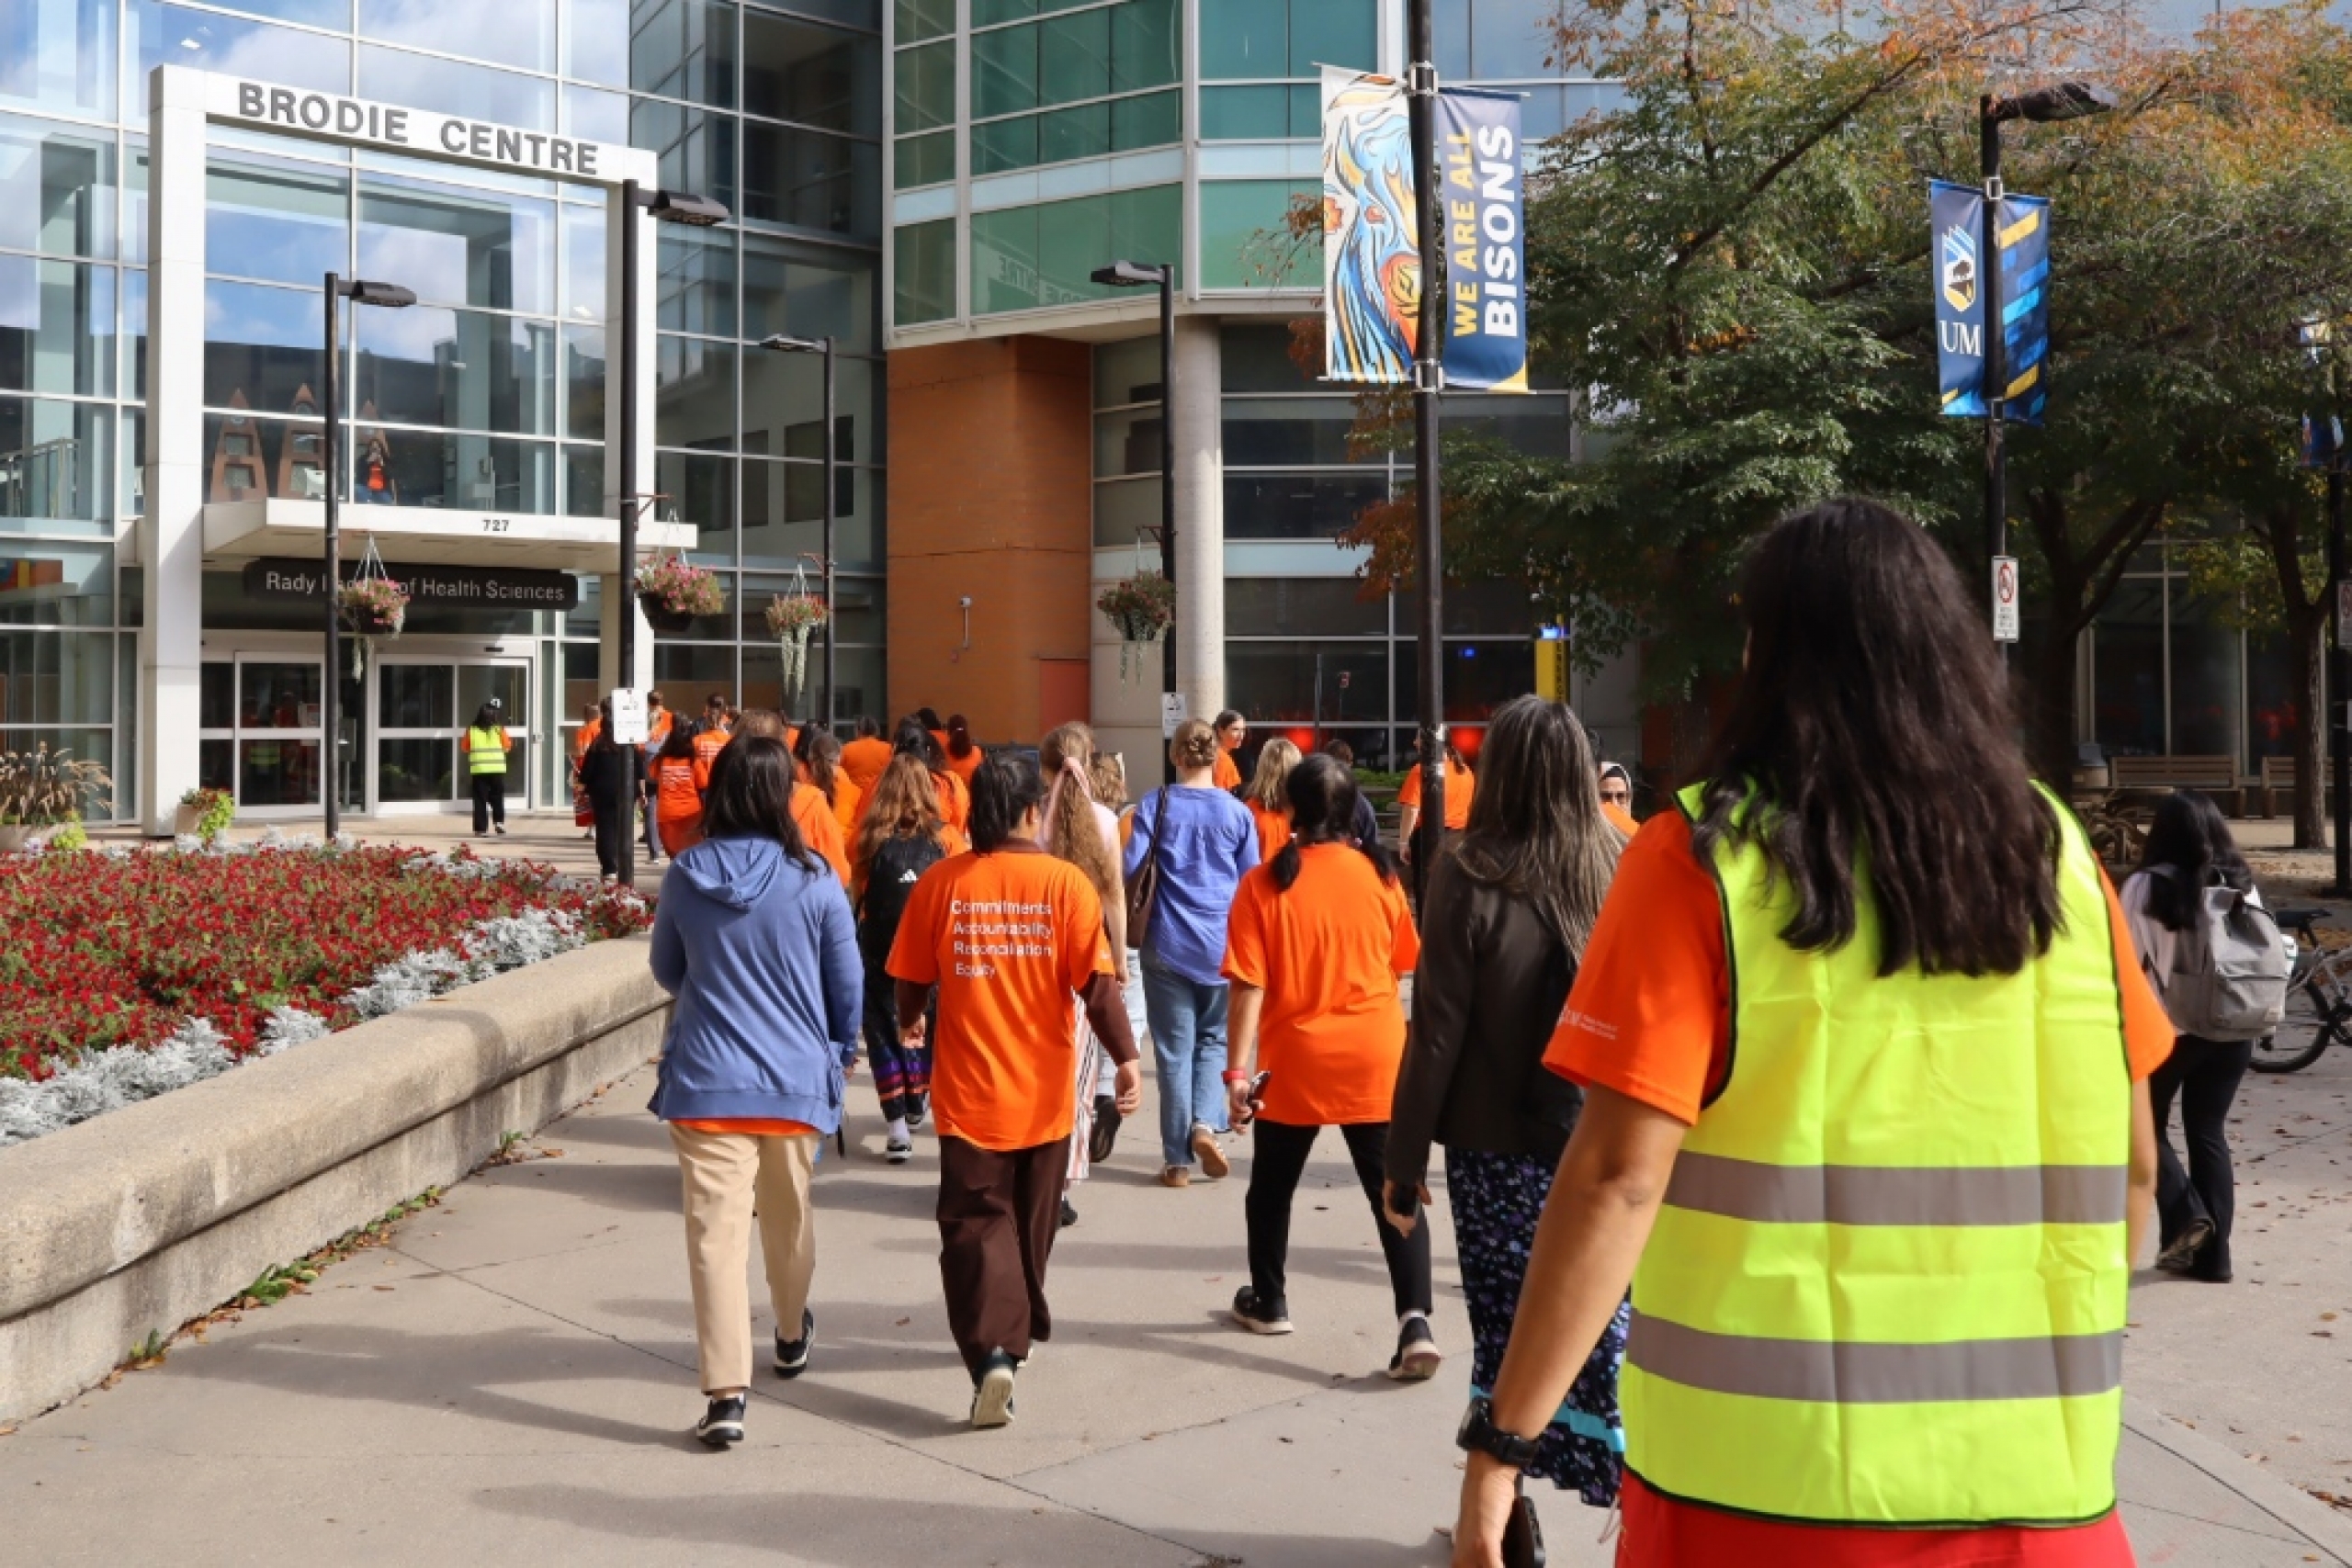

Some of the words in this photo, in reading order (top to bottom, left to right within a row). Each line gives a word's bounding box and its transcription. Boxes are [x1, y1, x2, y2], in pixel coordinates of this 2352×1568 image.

[238, 82, 409, 143] BRODIE
[440, 120, 599, 175] CENTRE
[1447, 125, 1474, 189] ALL
[1452, 200, 1478, 272] ARE
[1478, 125, 1519, 337] BISONS
[1453, 281, 1478, 337] WE
[1939, 320, 1982, 356] UM
[482, 519, 510, 532] 727
[266, 570, 317, 596] Rady
[422, 578, 481, 597] Health
[485, 580, 566, 602] Sciences
[951, 899, 1052, 915] Commitments
[954, 921, 1054, 940] Accountability
[954, 940, 1053, 957] Reconciliation
[956, 963, 996, 980] Equity
